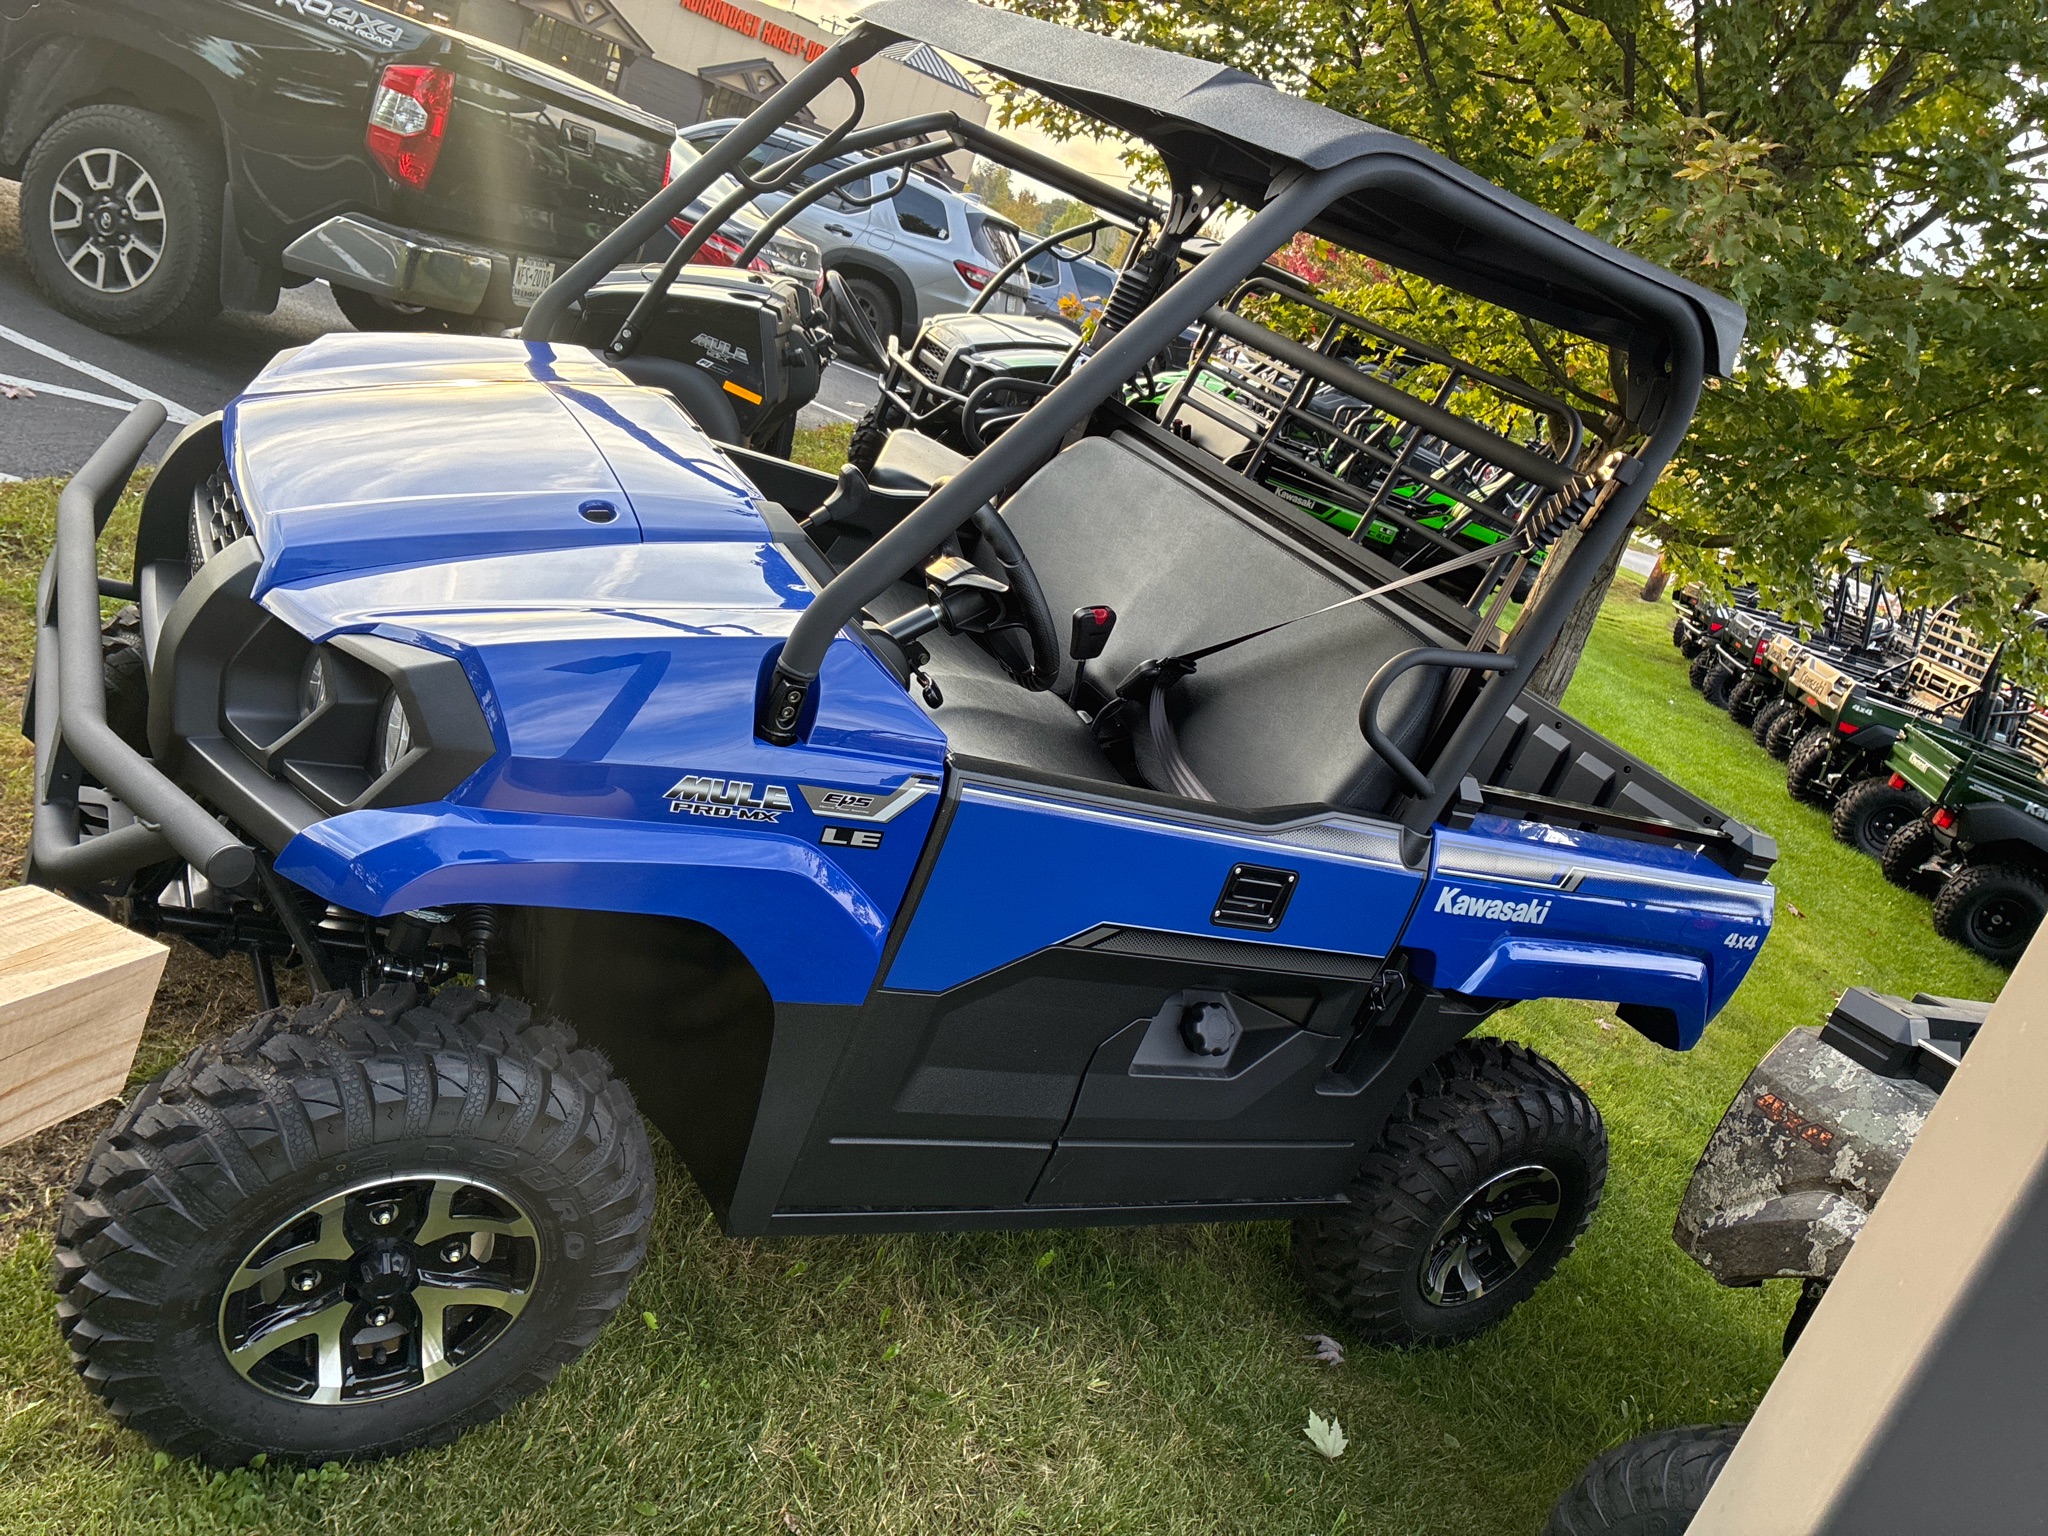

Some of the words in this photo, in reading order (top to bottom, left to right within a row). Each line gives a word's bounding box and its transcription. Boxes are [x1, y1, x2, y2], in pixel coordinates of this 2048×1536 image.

[326, 17, 355, 32] OFF
[355, 28, 393, 48] ROAD
[760, 20, 829, 63] HARLEY-DA
[690, 332, 749, 365] MULE
[1274, 486, 1316, 510] Kawasaki
[1851, 703, 1873, 717] 4x4
[662, 775, 794, 812] MULE
[822, 792, 873, 808] EPS
[670, 801, 780, 824] PRO-MX
[821, 827, 882, 848] LE
[1434, 886, 1552, 925] Kawasaki
[1723, 932, 1758, 950] 4x4
